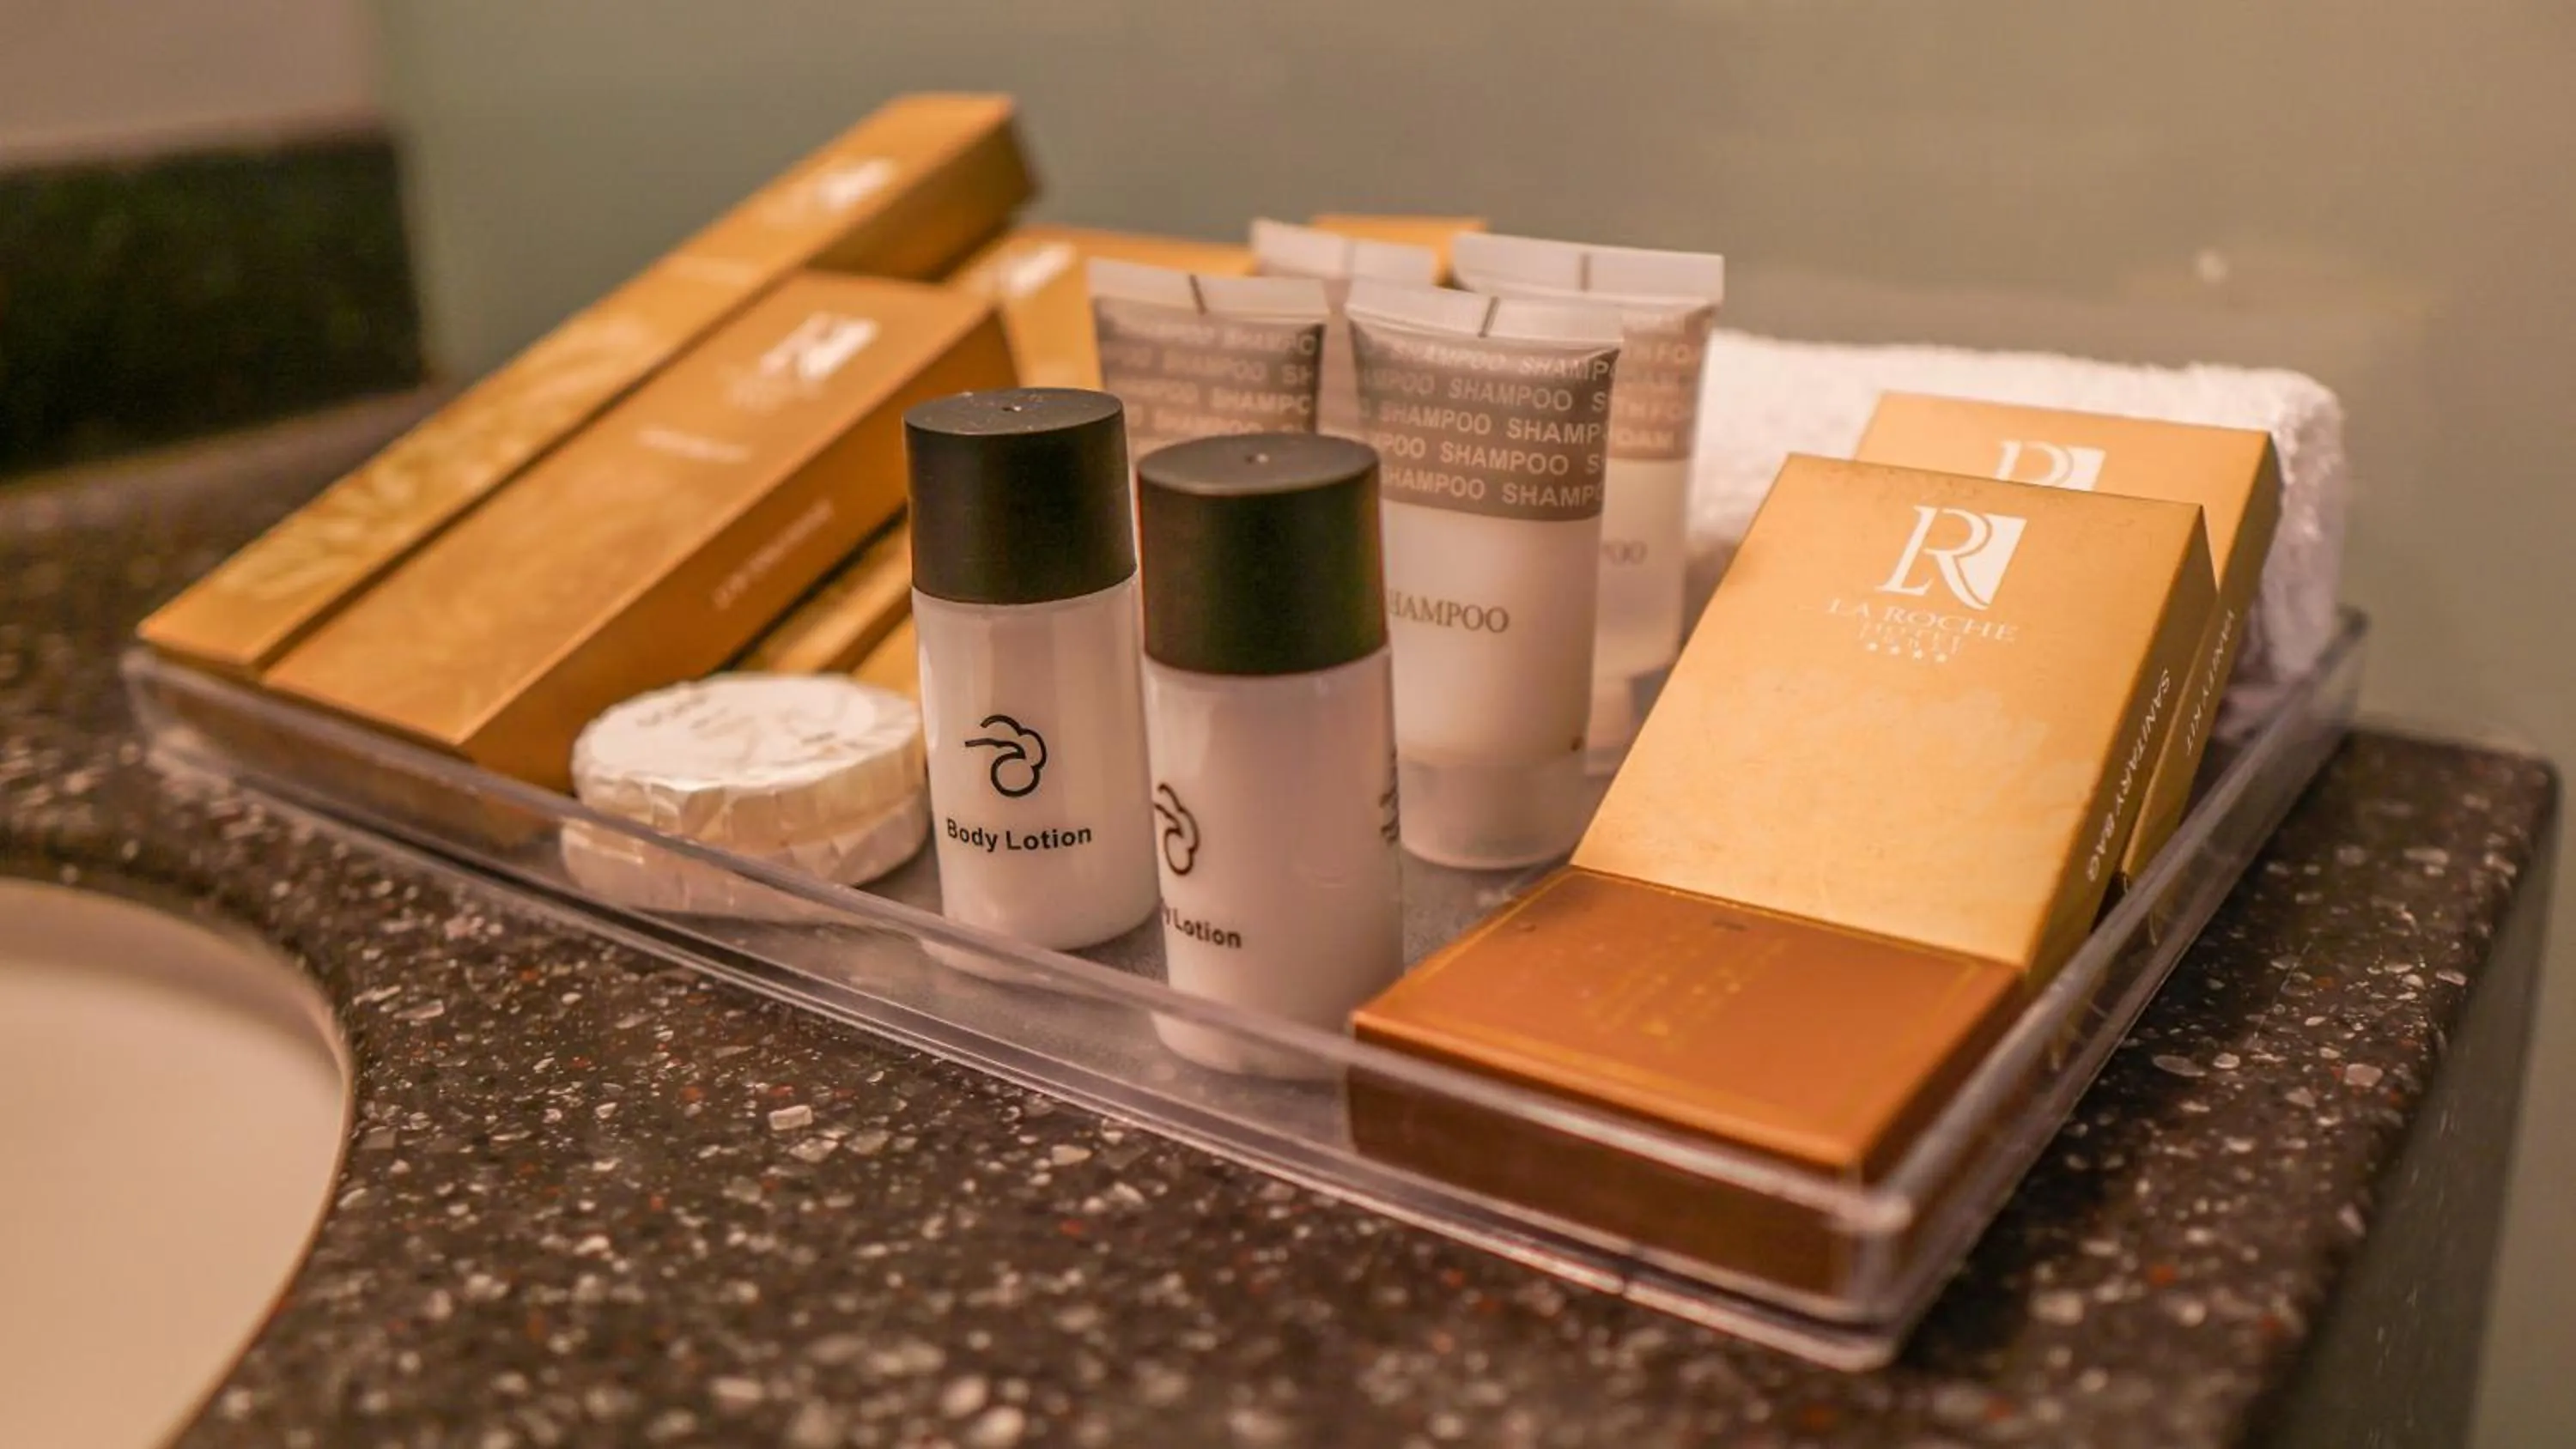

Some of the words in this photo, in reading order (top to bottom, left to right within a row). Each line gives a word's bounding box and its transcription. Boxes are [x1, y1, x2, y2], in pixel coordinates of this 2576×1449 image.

[1448, 377, 1573, 413] SHAMPOO
[1379, 399, 1492, 436] SHAMPOO
[1506, 416, 1608, 446] SHAMP
[1439, 440, 1571, 476] SHAMPOO
[1388, 588, 1510, 634] HAMPOO
[1826, 597, 1870, 618] LA
[1883, 605, 2021, 642] ROCHE
[2115, 667, 2171, 816] SANITARY
[945, 816, 999, 853] Body
[1005, 827, 1093, 852] Lotion
[2087, 812, 2116, 882] BAG
[1172, 906, 1243, 949] Lotion
